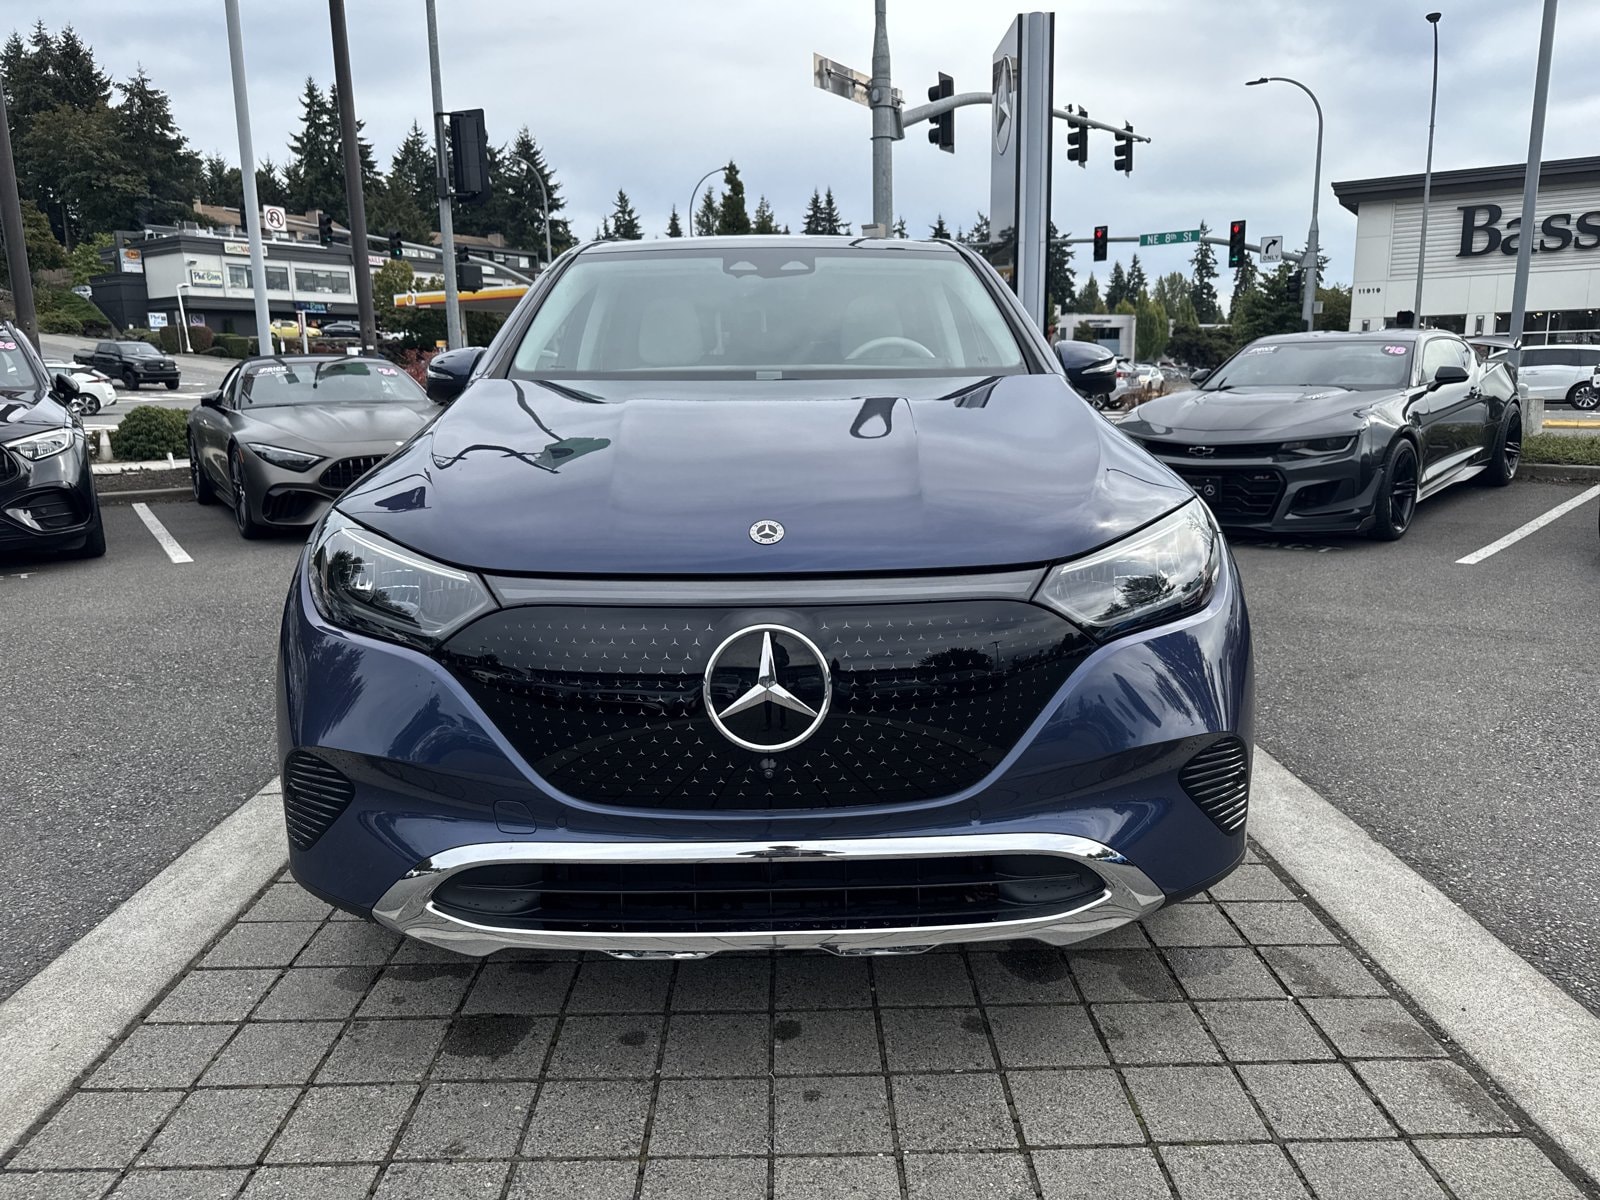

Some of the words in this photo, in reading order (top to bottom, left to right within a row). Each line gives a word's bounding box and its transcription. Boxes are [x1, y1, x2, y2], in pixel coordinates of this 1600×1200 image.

[1147, 234, 1159, 245] NE
[1165, 233, 1177, 243] 8th
[1182, 232, 1193, 242] St
[1456, 204, 1600, 257] Bass
